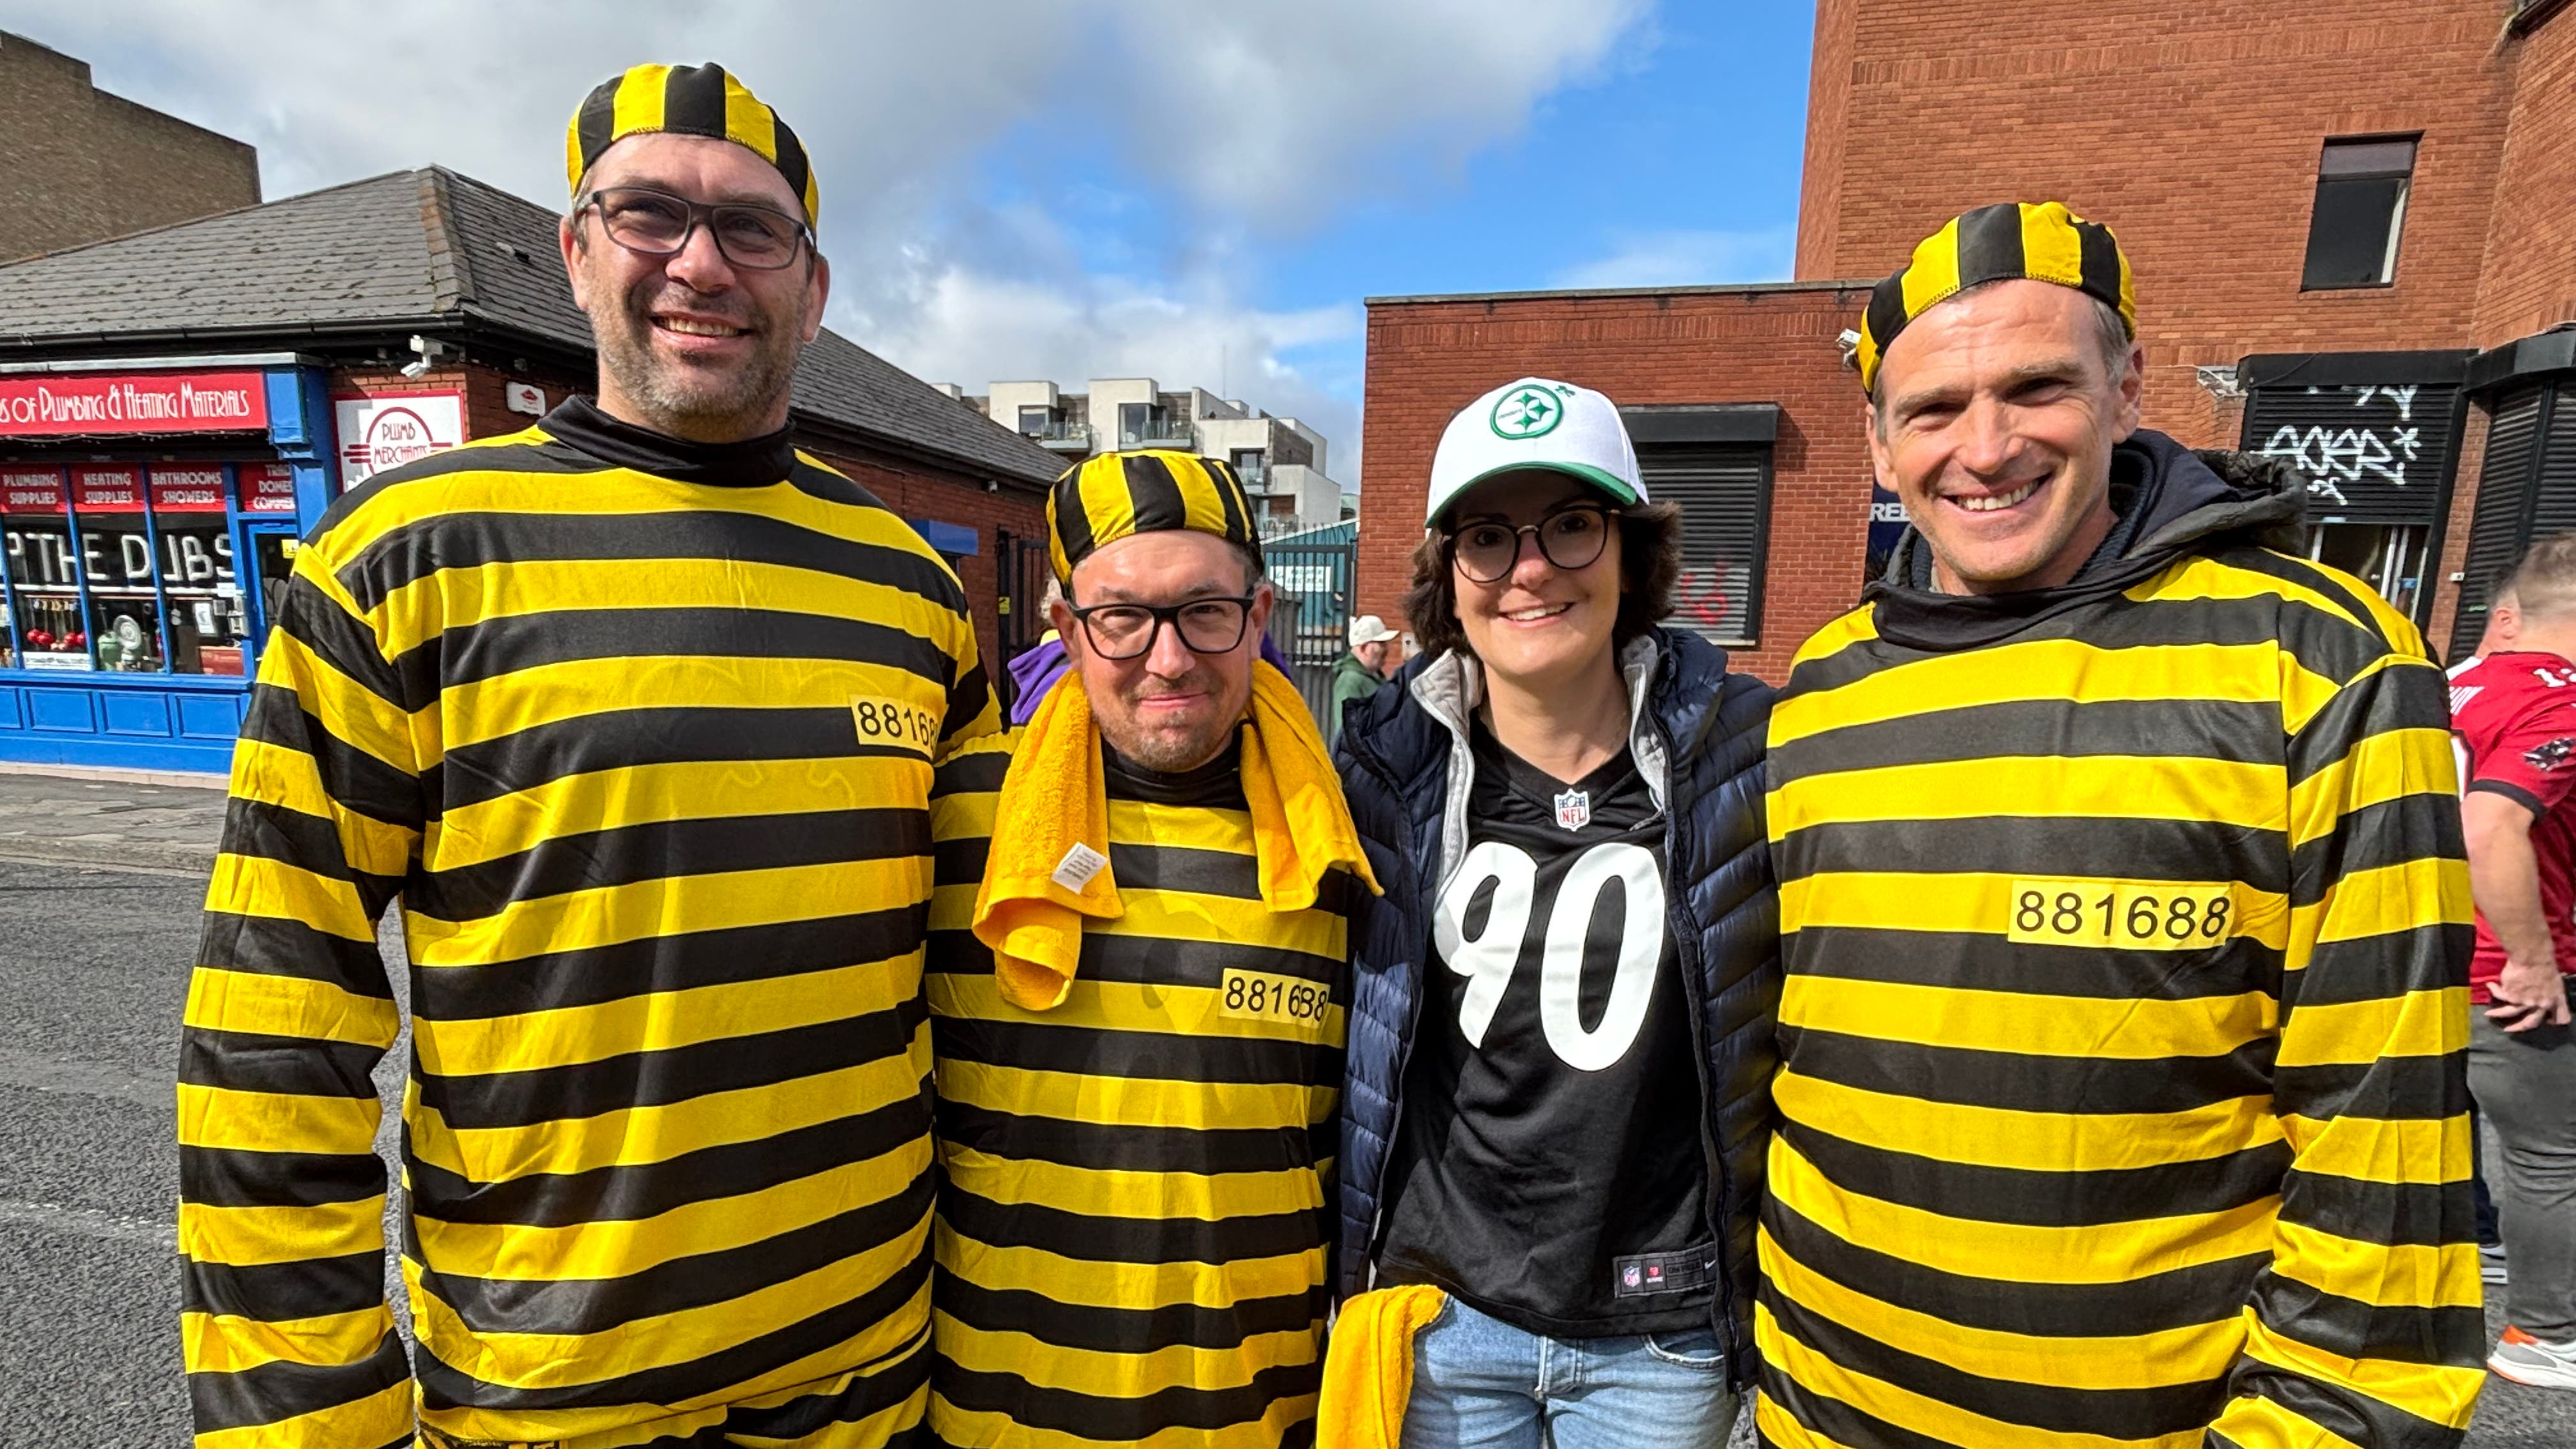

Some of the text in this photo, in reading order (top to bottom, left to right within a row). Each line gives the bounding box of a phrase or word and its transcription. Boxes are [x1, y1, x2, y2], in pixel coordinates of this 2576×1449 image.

[107, 384, 123, 420] &
[382, 422, 416, 441] PLUMB
[3, 473, 58, 487] PLUMBING
[83, 472, 132, 486] HEATING
[151, 471, 222, 486] BATHROOMS
[9, 491, 57, 505] SUPPLIES
[85, 491, 133, 504] SUPPLIES
[162, 490, 216, 504] SHOWERS
[1561, 808, 1586, 824] NFL
[2016, 890, 2231, 940] 881688
[1433, 841, 1666, 1073] 90
